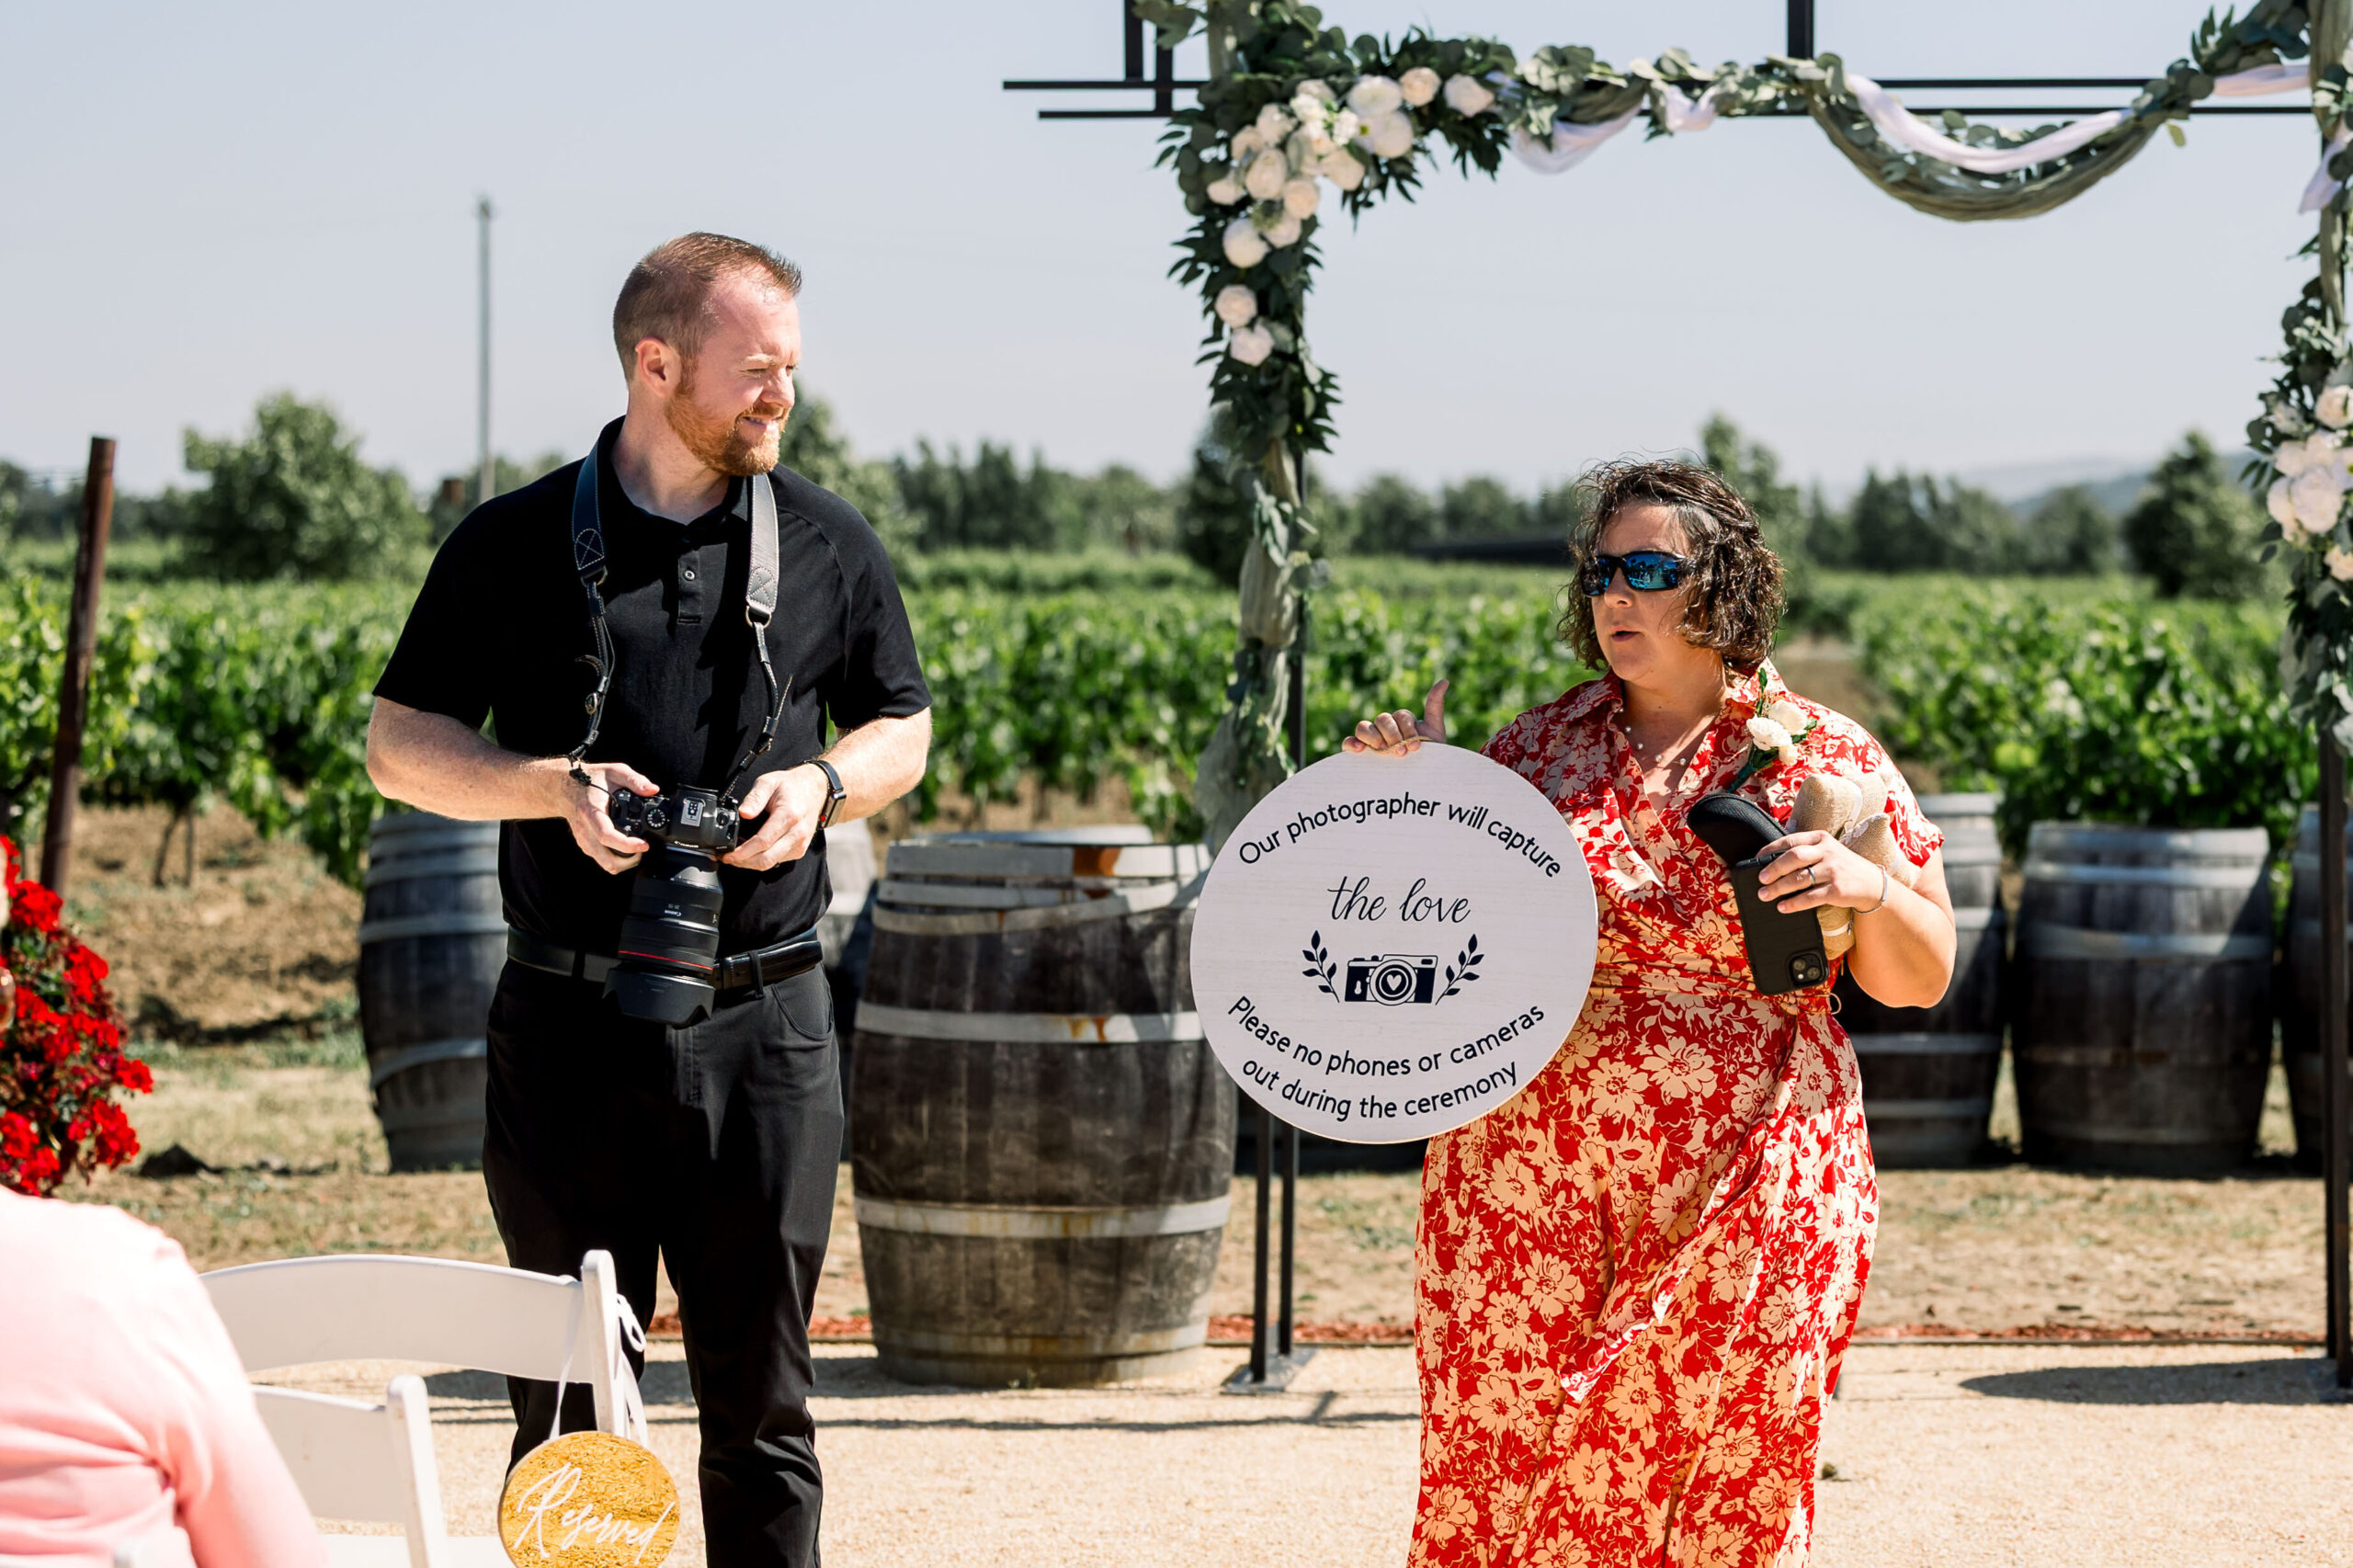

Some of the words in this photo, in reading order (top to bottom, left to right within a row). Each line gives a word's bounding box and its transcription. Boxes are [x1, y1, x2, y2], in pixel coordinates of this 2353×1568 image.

[1240, 830, 1281, 865] Our
[1286, 791, 1442, 844] photographer
[1449, 803, 1489, 830] will
[1487, 820, 1561, 878] capture
[1327, 875, 1387, 922] the
[1399, 877, 1472, 924] love
[1227, 995, 1291, 1053] Please
[1292, 1043, 1323, 1066] no
[1324, 1050, 1412, 1076] phones
[1417, 1052, 1442, 1073] or
[1449, 1006, 1544, 1064] cameras
[1243, 1060, 1280, 1092] out
[1281, 1078, 1352, 1122] during
[1358, 1095, 1398, 1119] the
[1404, 1061, 1517, 1116] ceremony
[512, 1461, 676, 1565] Reserved
